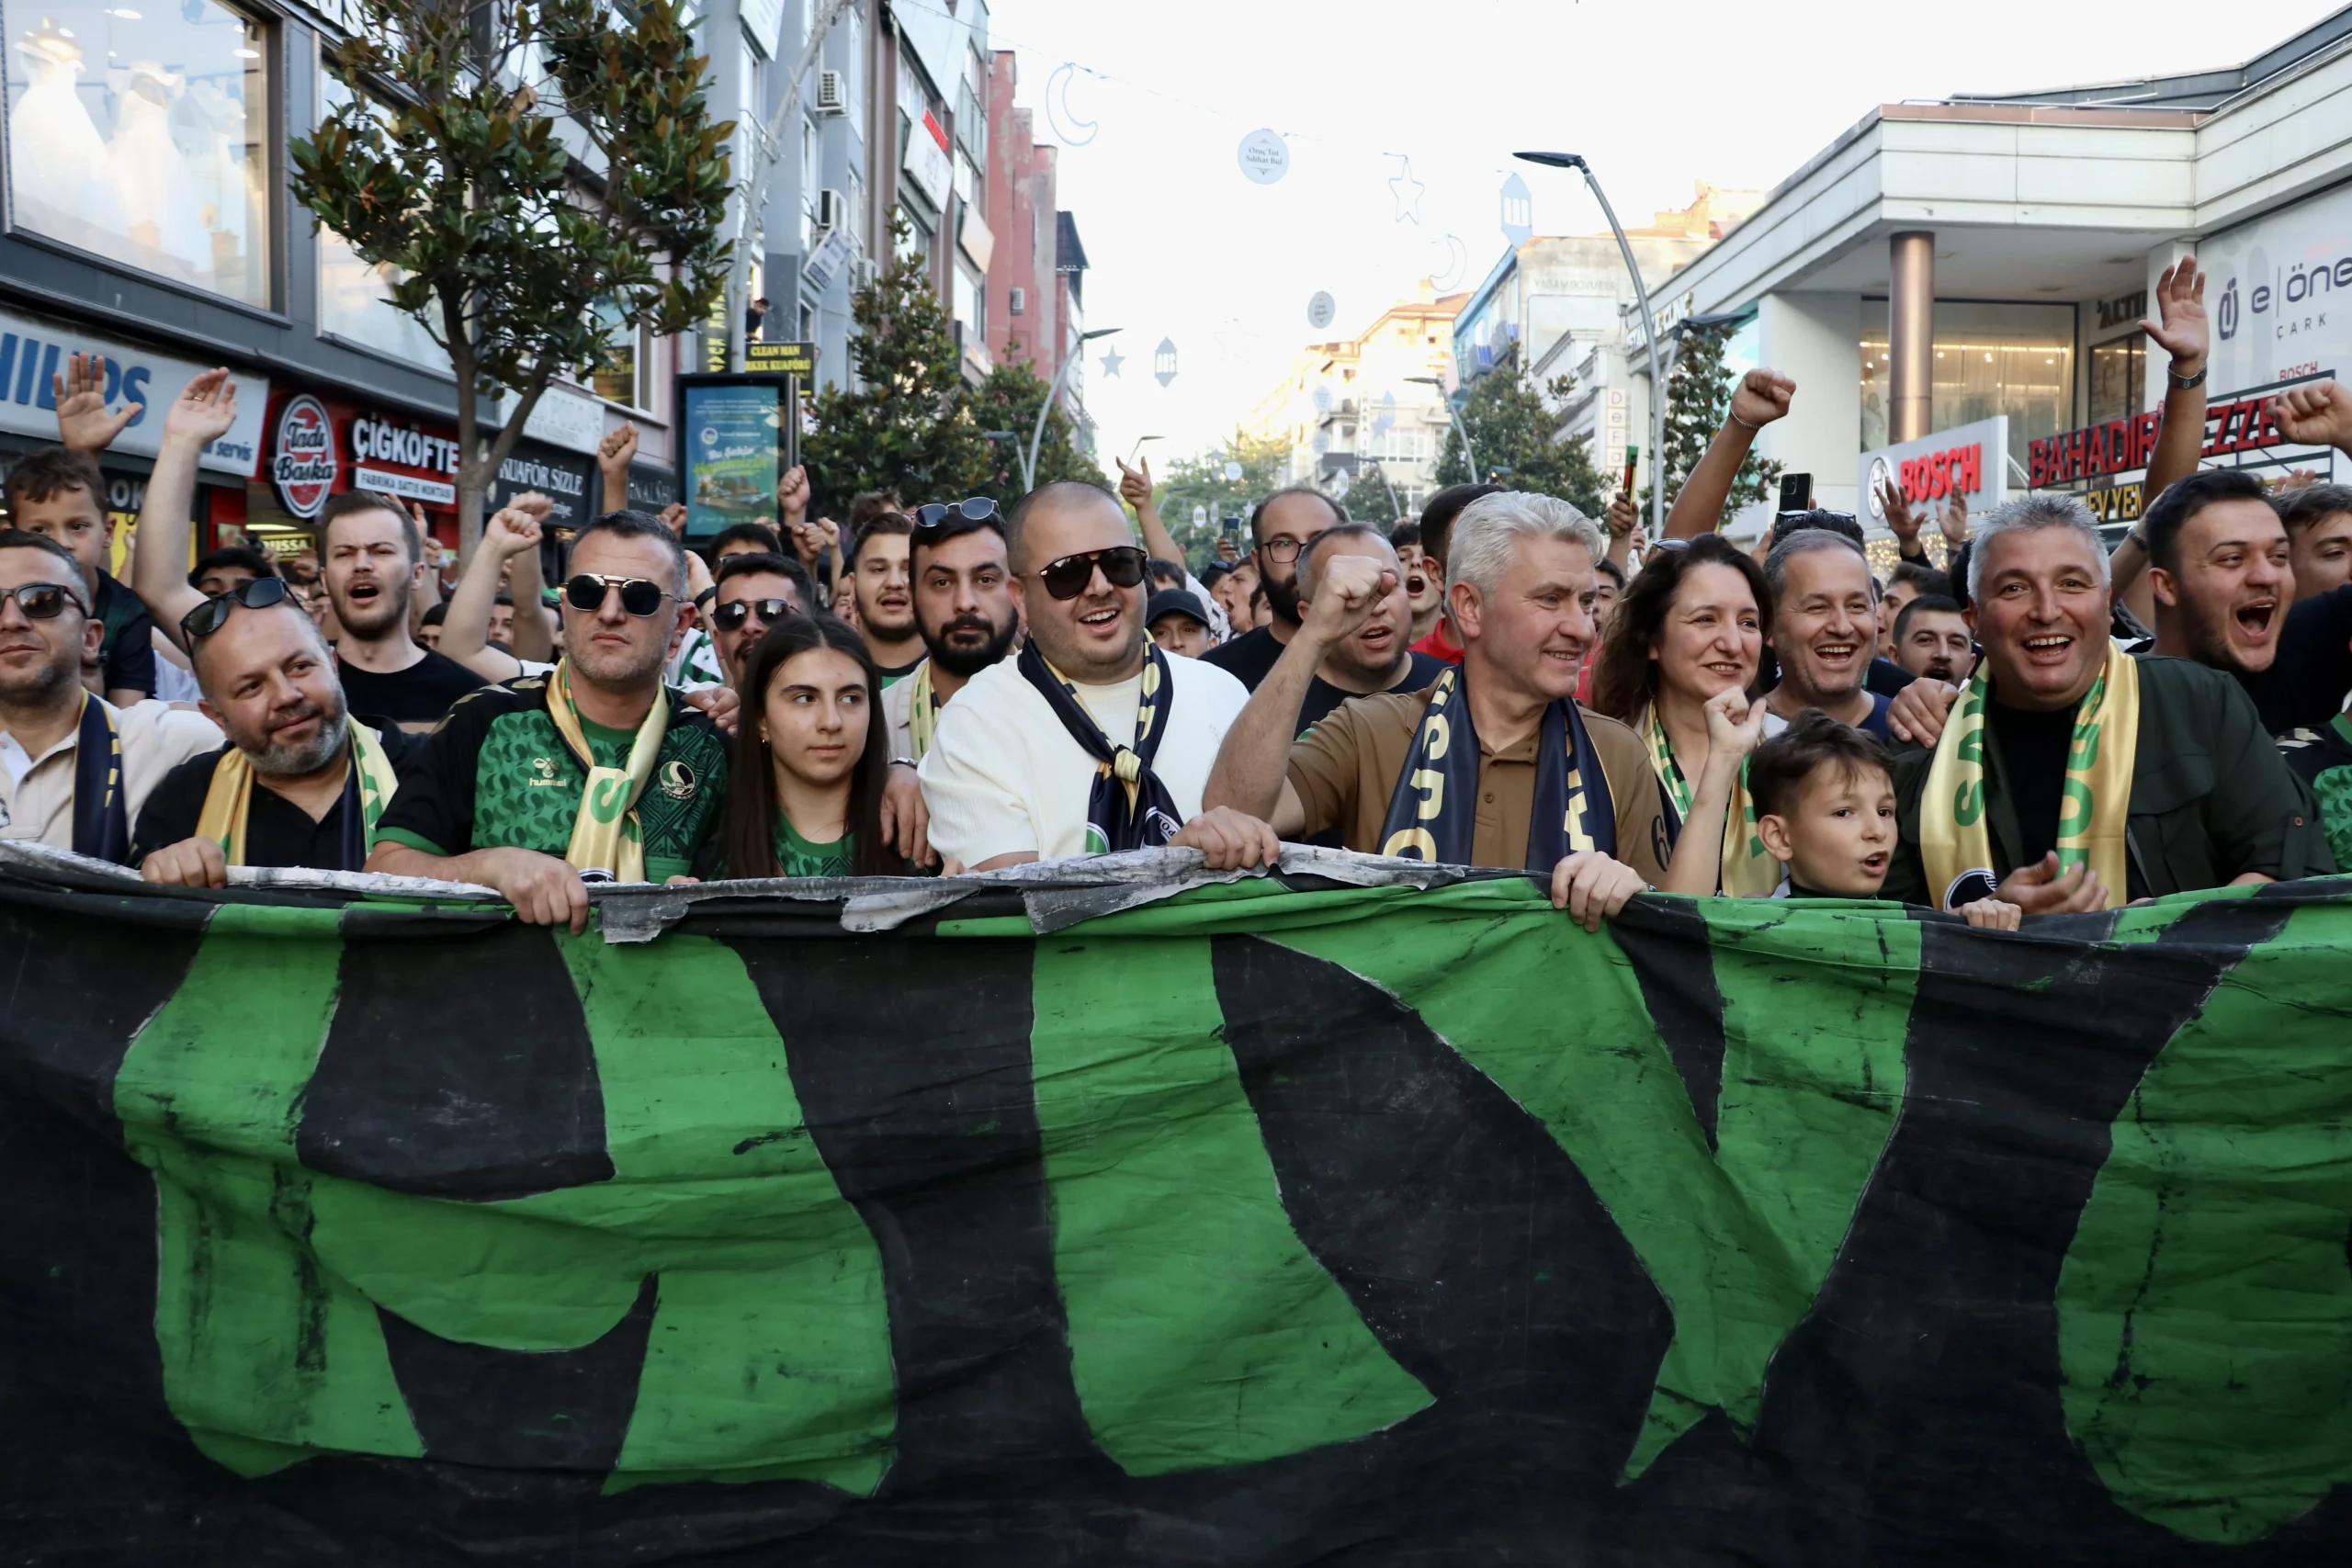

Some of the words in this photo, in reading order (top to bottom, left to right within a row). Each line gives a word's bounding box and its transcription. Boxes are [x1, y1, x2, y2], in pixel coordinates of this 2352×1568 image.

[2276, 312, 2327, 341] ÇARK
[0, 332, 151, 428] ILPS
[2279, 361, 2319, 382] BOSCH
[216, 441, 253, 462] servis
[352, 412, 460, 475] ÇİĞKÖFTE
[2029, 412, 2161, 488] BAHADIR
[1899, 441, 1982, 504] BOSCH
[2087, 489, 2109, 522] EV
[528, 776, 568, 787] hummel
